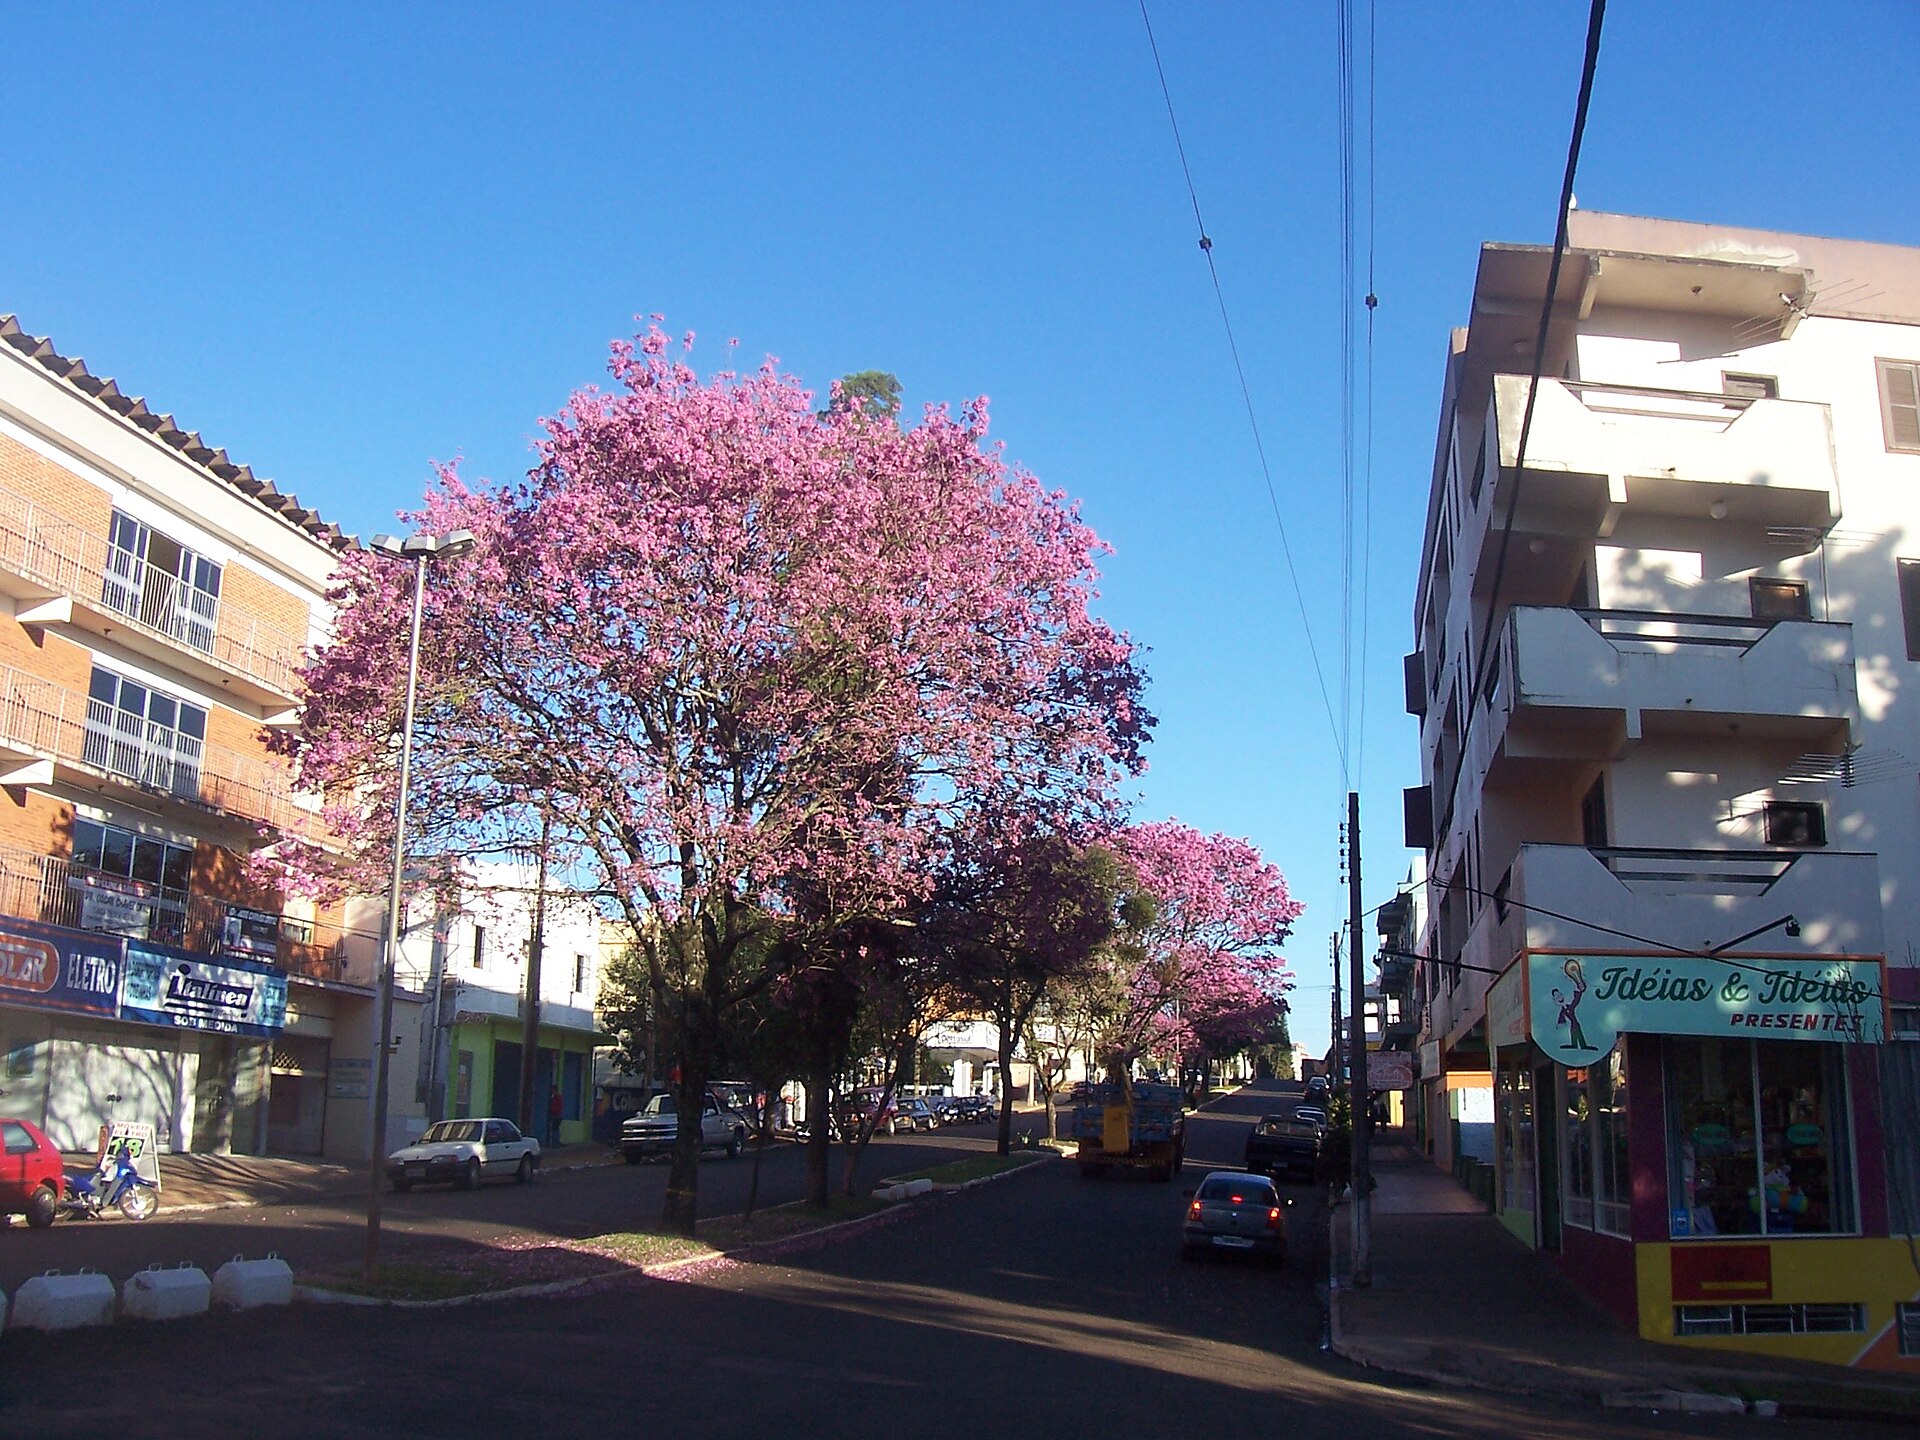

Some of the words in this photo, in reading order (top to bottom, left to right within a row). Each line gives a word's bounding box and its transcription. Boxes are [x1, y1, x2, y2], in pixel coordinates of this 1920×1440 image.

[66, 953, 117, 994] ELETRO
[1595, 967, 1714, 1001] Idéias
[1721, 972, 1749, 1002] &
[1758, 970, 1873, 1004] Idéias
[174, 1015, 197, 1028] SOB
[198, 1017, 238, 1033] MEDIDA
[1730, 1013, 1865, 1032] PRESENTES
